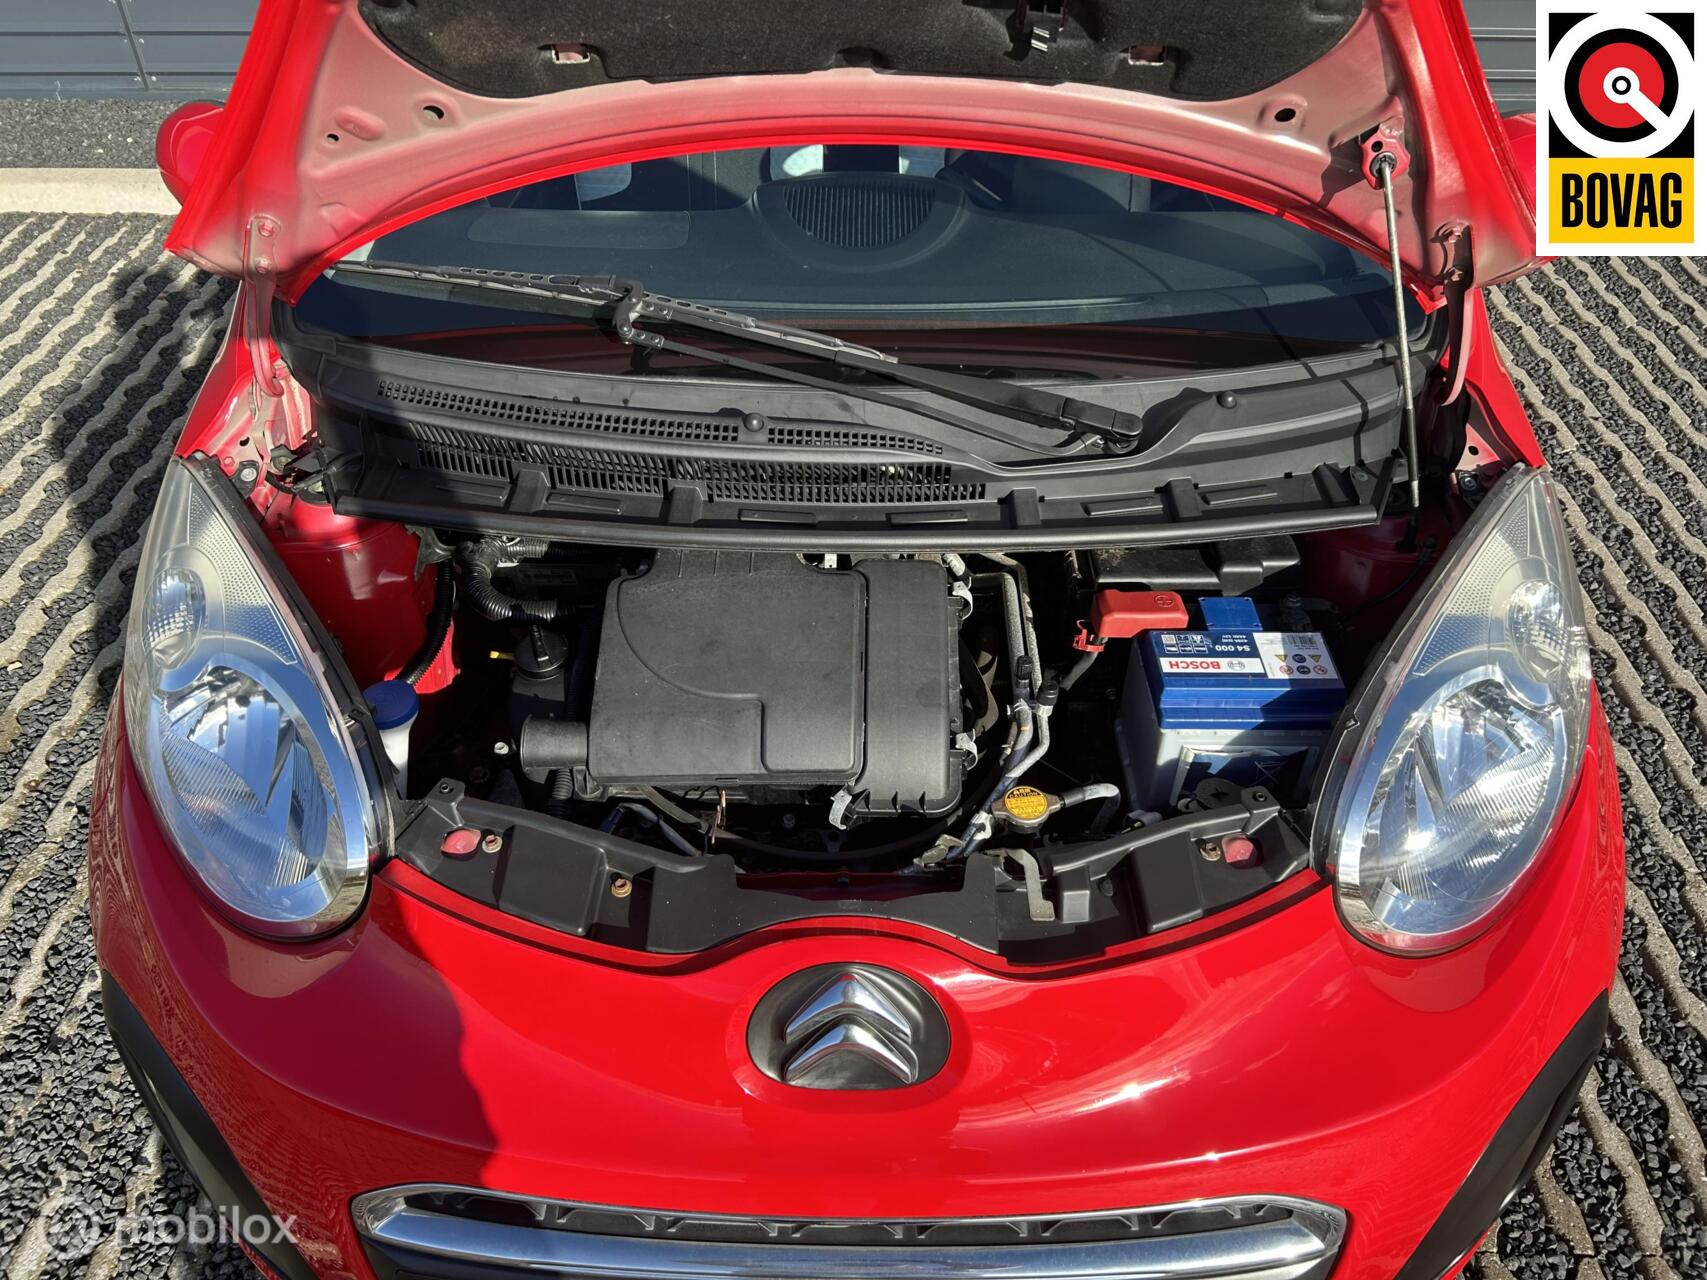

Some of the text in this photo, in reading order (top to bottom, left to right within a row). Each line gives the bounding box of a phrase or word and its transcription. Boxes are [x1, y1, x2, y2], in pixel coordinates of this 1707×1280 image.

[1215, 644, 1251, 652] S4 000
[1168, 660, 1222, 670] BOSCH
